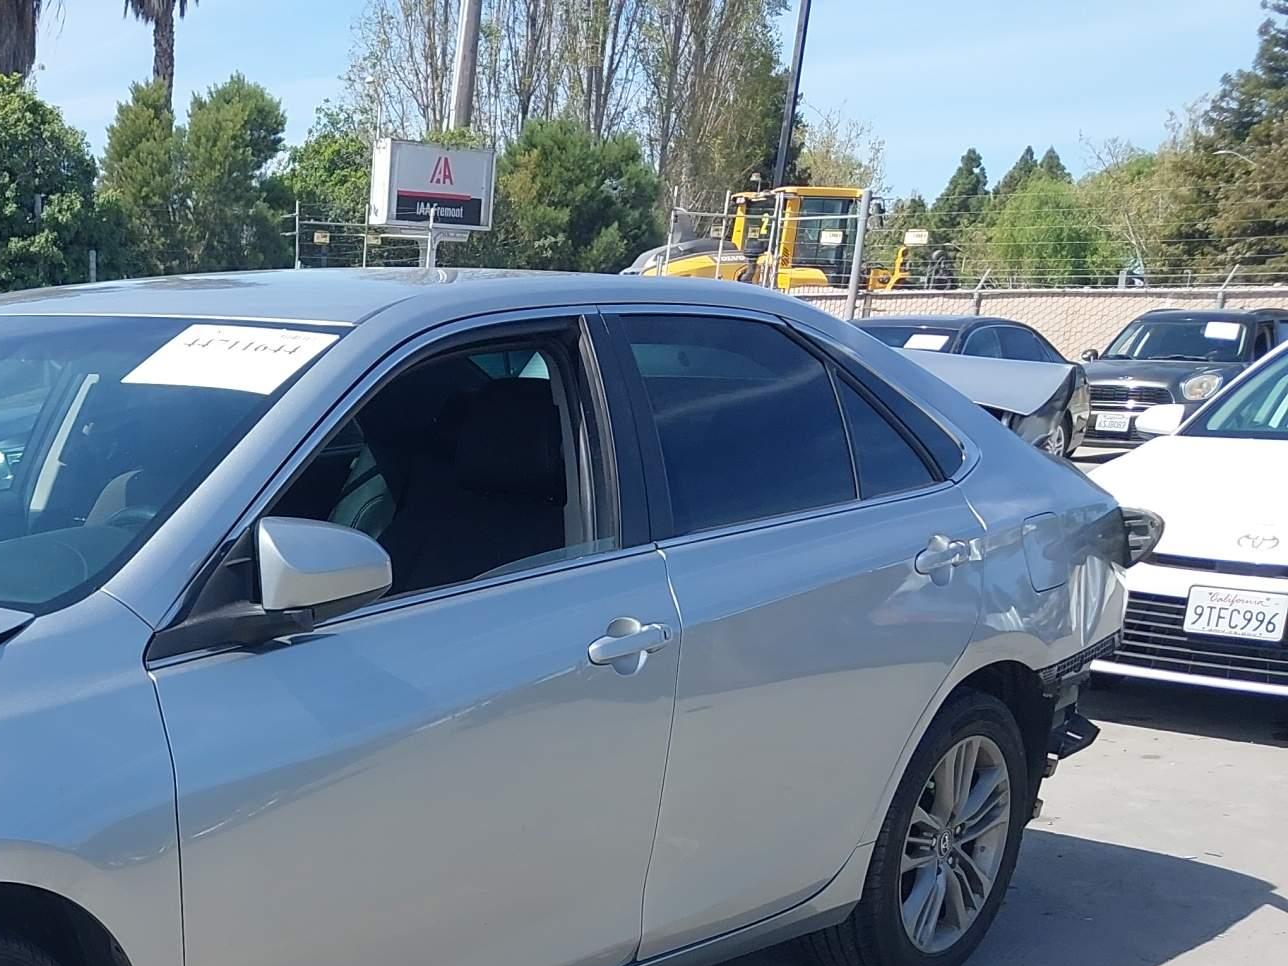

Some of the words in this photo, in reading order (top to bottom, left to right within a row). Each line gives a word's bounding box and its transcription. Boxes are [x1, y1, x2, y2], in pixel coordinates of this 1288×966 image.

[416, 201, 431, 216] IAA
[432, 203, 464, 218] Fremont
[760, 212, 769, 235] 2
[1208, 591, 1270, 608] California
[1191, 604, 1280, 633] 9TFC996
